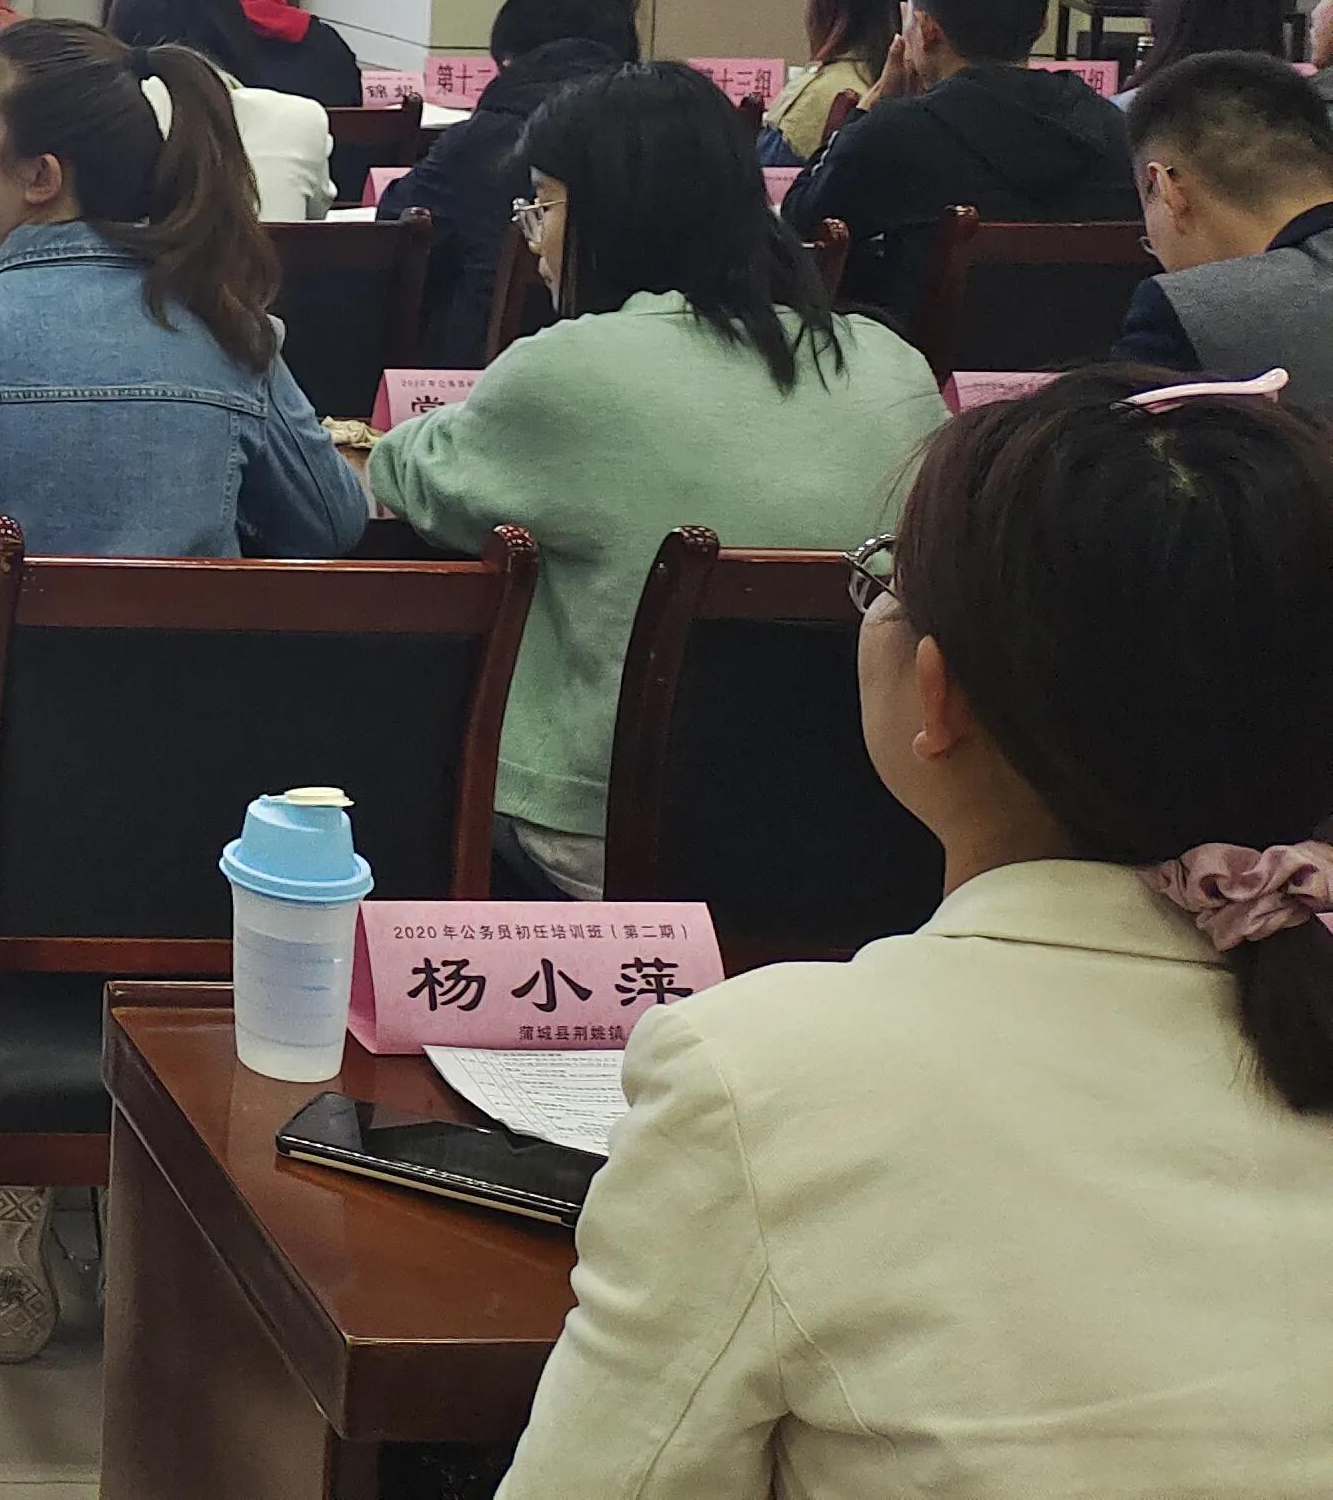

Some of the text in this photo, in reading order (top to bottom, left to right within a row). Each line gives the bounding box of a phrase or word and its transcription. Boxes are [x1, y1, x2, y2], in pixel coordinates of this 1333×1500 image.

[700, 67, 772, 98] 十三组
[406, 957, 696, 1013] 杨小萍
[519, 1025, 629, 1042] 蒲城县荆姚镇
